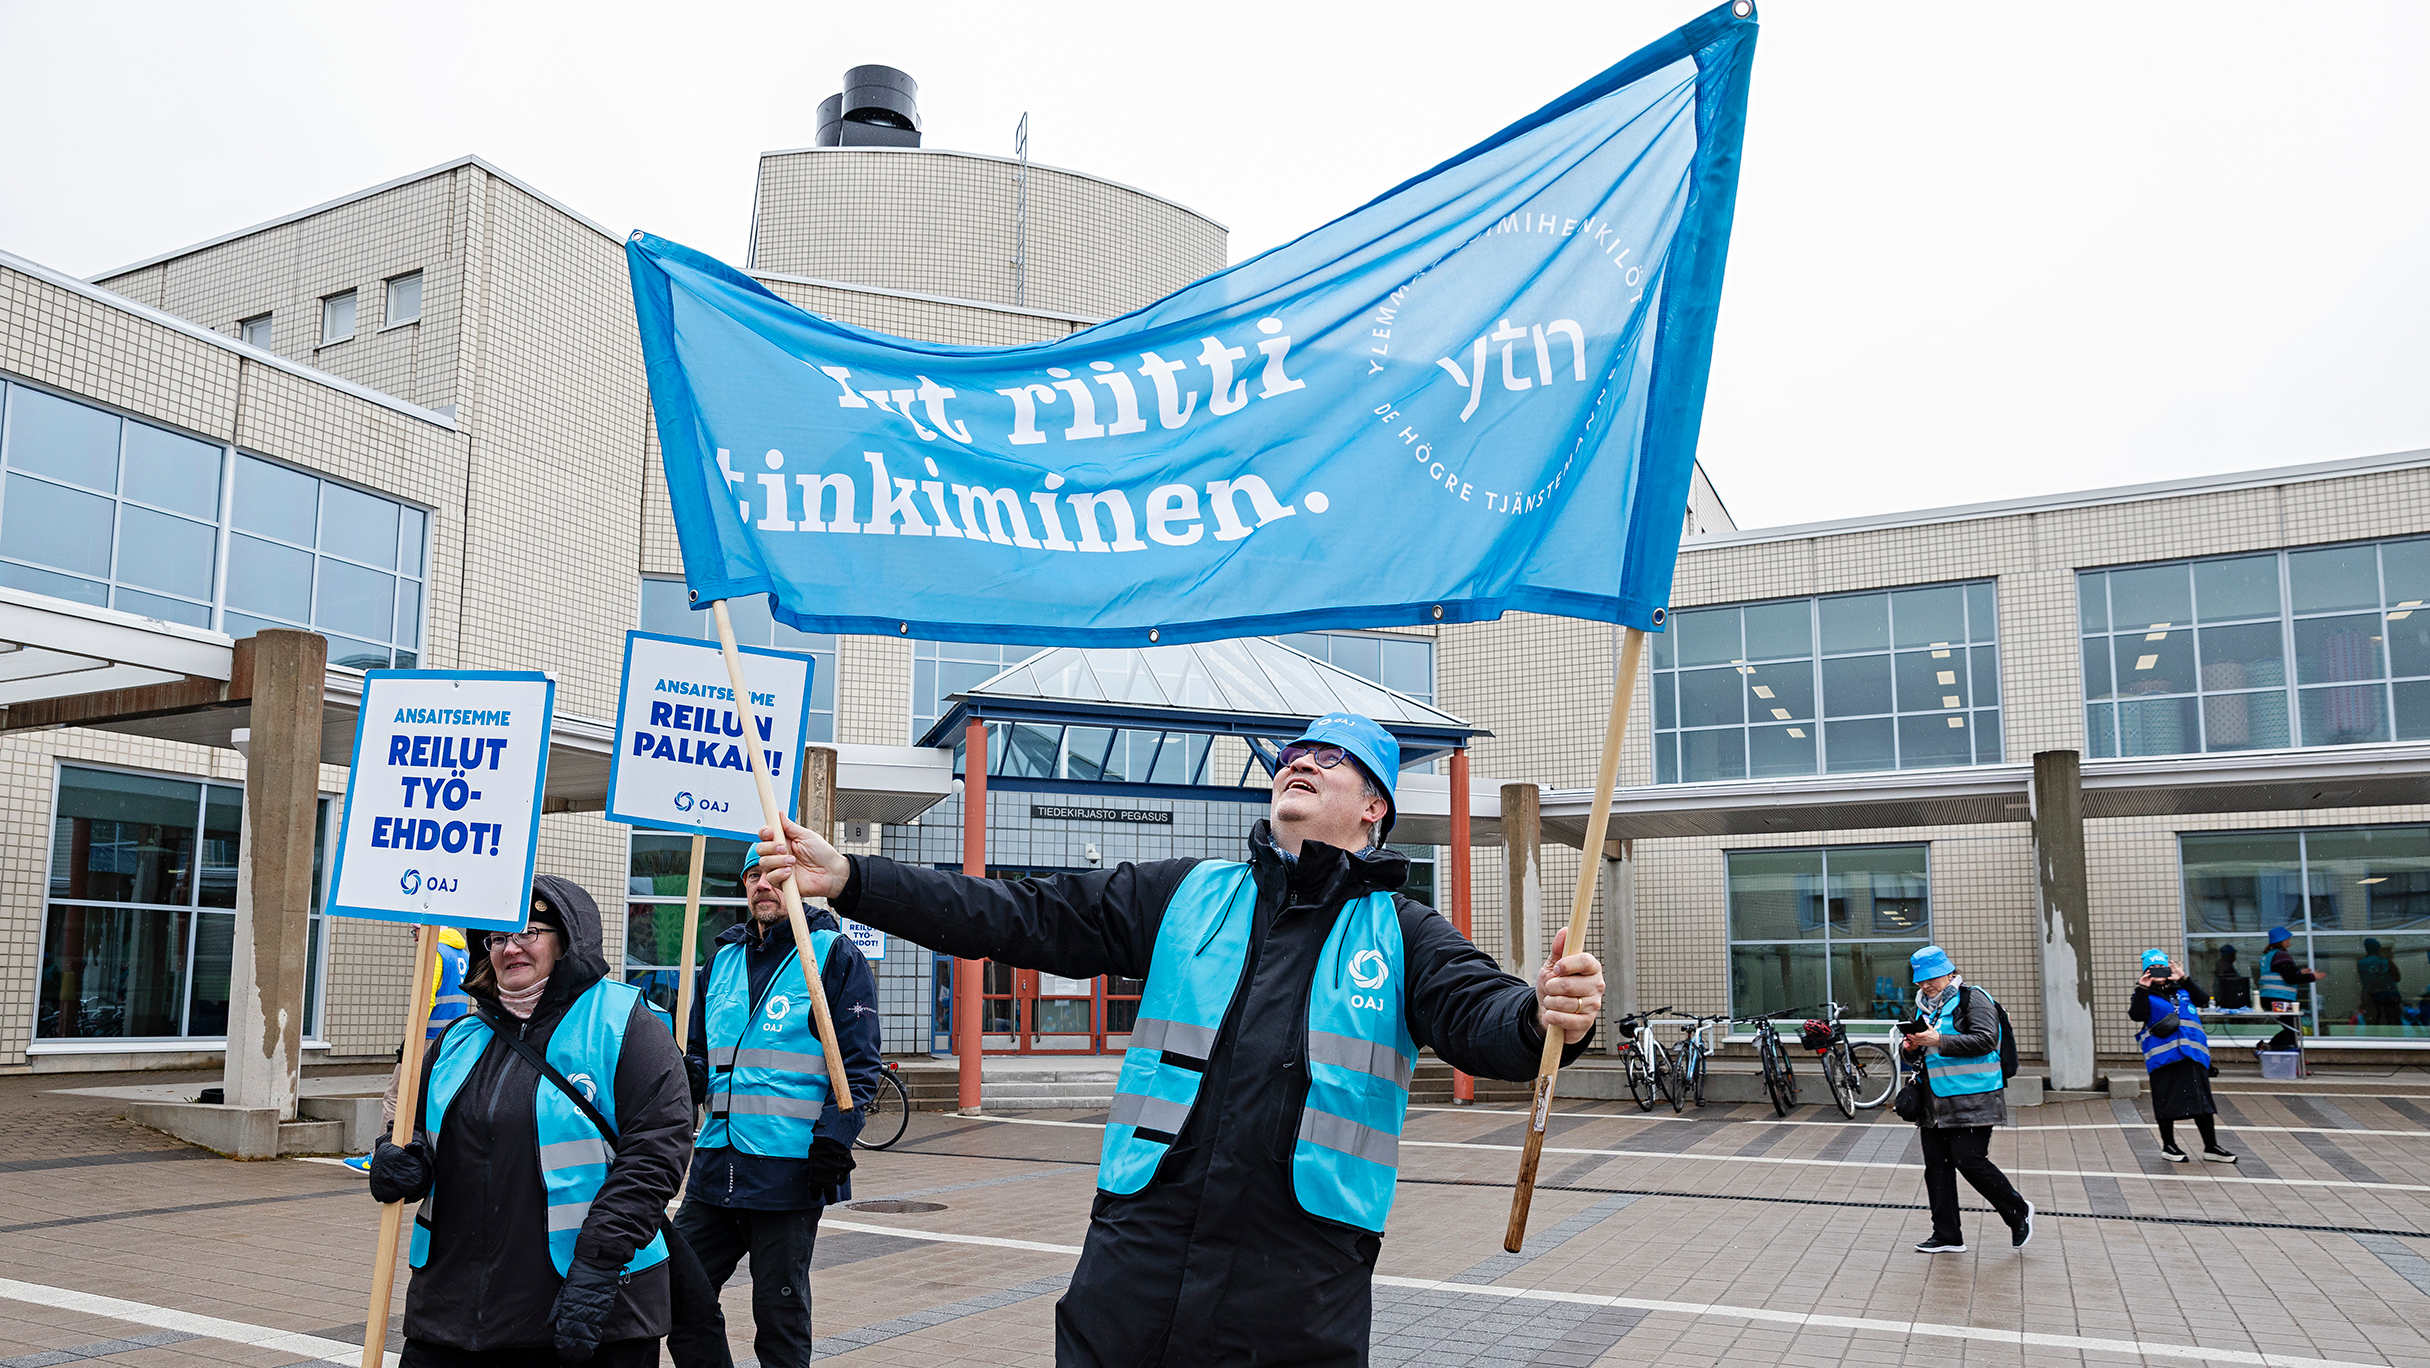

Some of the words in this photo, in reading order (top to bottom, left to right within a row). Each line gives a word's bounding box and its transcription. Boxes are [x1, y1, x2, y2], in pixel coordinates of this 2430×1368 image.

[1368, 257, 1442, 375] YLEMM
[994, 317, 1306, 445] riitti
[1436, 318, 1586, 423] ytn
[1373, 402, 1400, 424] DE
[1398, 425, 1474, 502] HÖGRE
[654, 678, 776, 708] ANSAITSEME
[393, 708, 512, 727] ANSAITSEMME
[650, 700, 773, 742] REILUN
[388, 735, 508, 771] REILUT
[401, 769, 482, 811] TYÖ-
[699, 799, 730, 813] OAJ
[1037, 806, 1117, 820] TIEDEKIRJASTO
[1121, 811, 1169, 822] PEGASUS
[371, 816, 502, 857] EHDOT!
[427, 877, 458, 893] OAJ
[1351, 994, 1384, 1011] OAJ
[763, 1023, 783, 1032] OAJ
